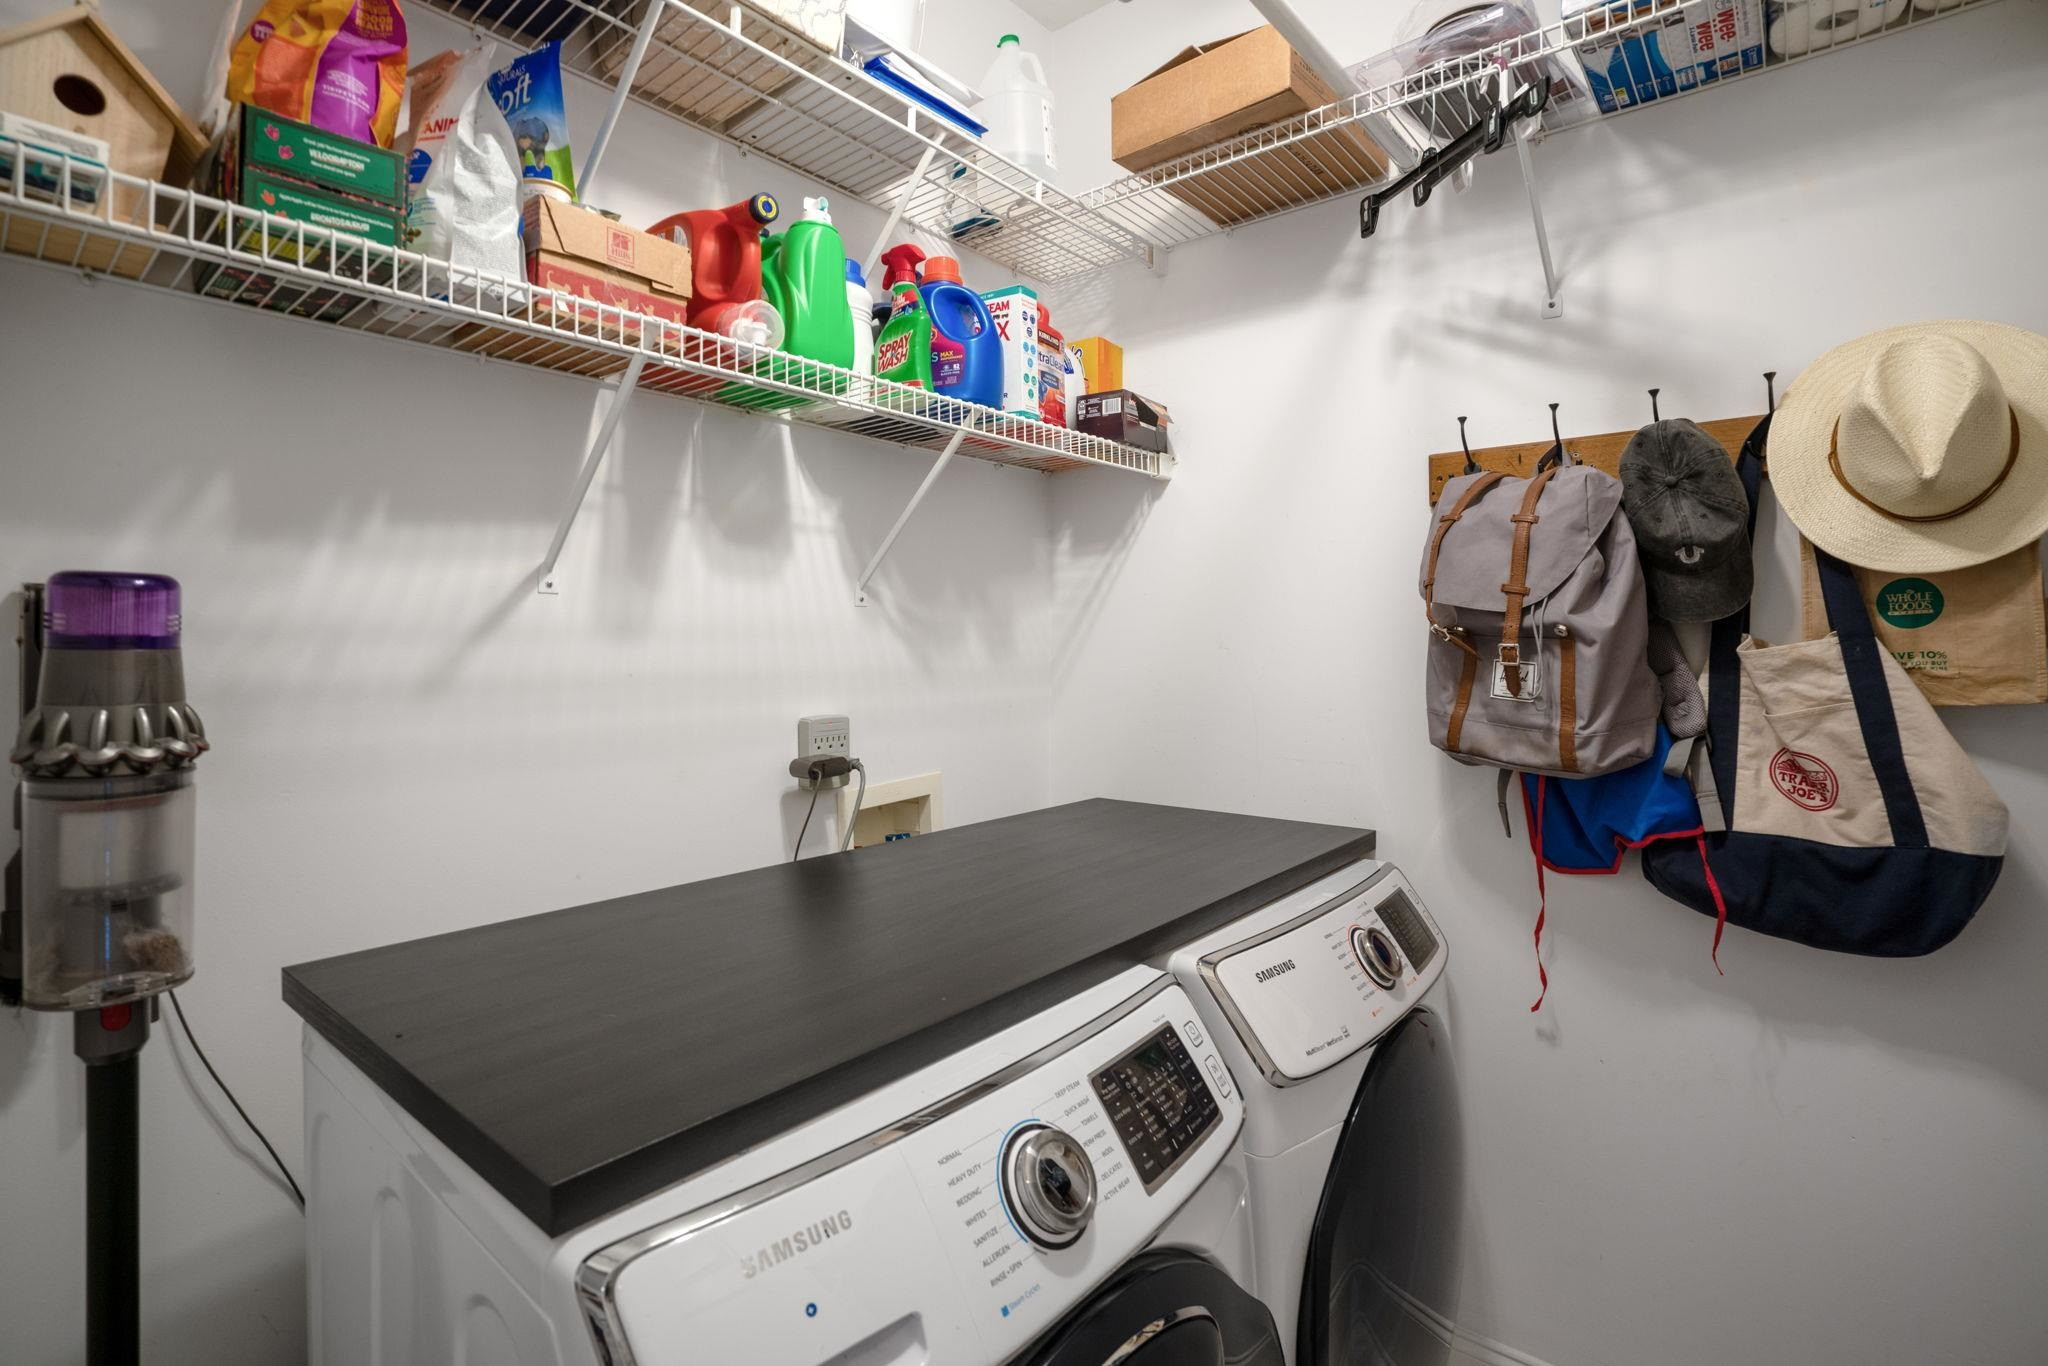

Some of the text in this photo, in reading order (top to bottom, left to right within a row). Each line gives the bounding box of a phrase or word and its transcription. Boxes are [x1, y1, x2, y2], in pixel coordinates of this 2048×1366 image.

[880, 331, 912, 360] SPRAY
[876, 347, 909, 373] WASH
[1886, 590, 1933, 602] WHOLE
[1888, 600, 1932, 611] FOODS
[1920, 651, 1947, 660] 10%
[1255, 959, 1296, 983] SAMSUNG
[937, 1149, 963, 1167] NORMAL
[947, 1162, 983, 1188] HEAVY DUTY
[956, 1186, 983, 1208] BEDDING
[964, 1209, 988, 1228] WHITES
[740, 1208, 853, 1280] SAMSUNG
[973, 1225, 999, 1248] SANITIZE
[982, 1243, 1011, 1268] ALLERGEN
